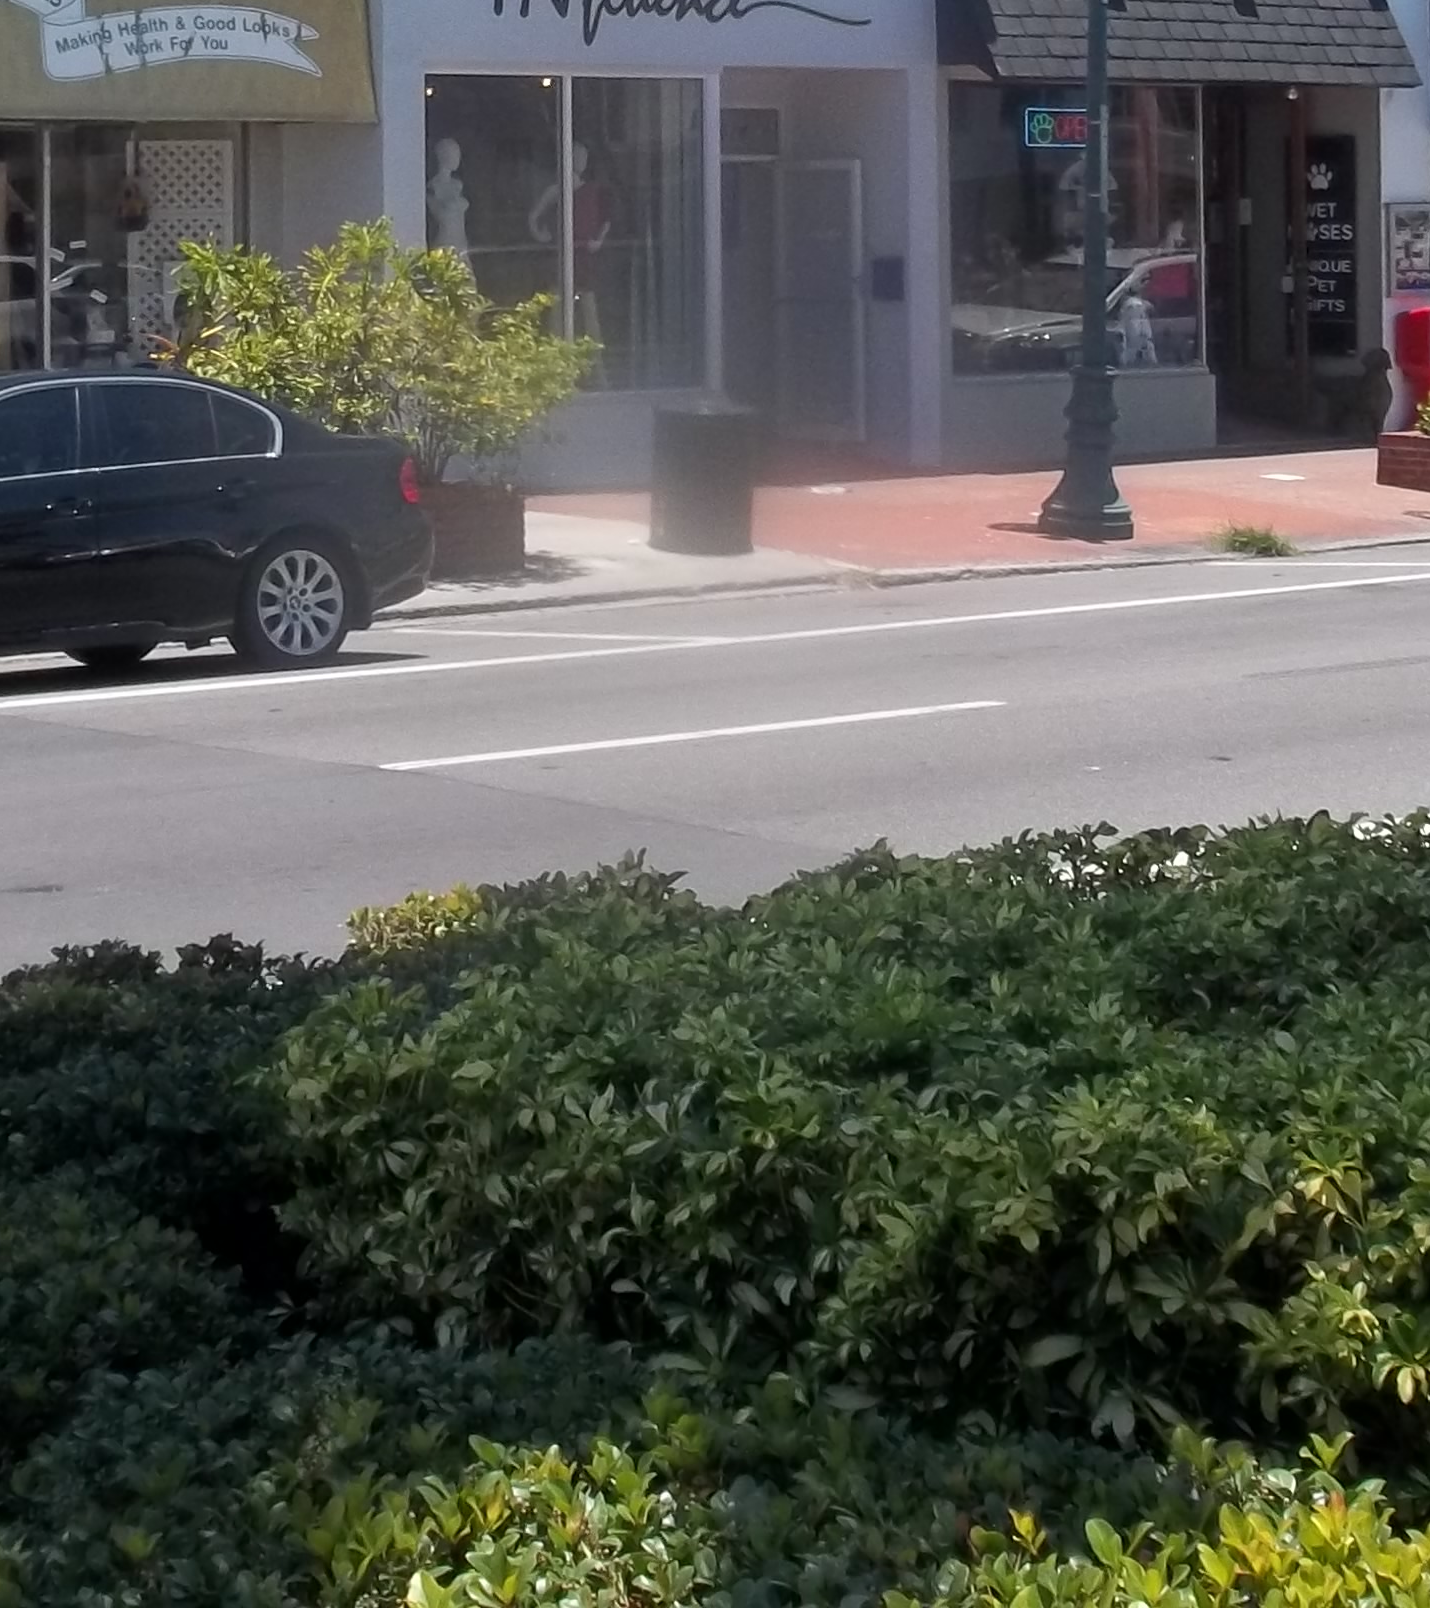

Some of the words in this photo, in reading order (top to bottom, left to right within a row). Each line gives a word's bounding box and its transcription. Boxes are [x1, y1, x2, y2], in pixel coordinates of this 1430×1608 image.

[55, 27, 113, 54] Making
[117, 17, 169, 38] Health
[175, 15, 186, 30] &
[193, 14, 236, 32] Good
[243, 16, 291, 38] Looks
[123, 38, 164, 57] Work
[170, 36, 194, 53] For
[200, 35, 229, 51] You
